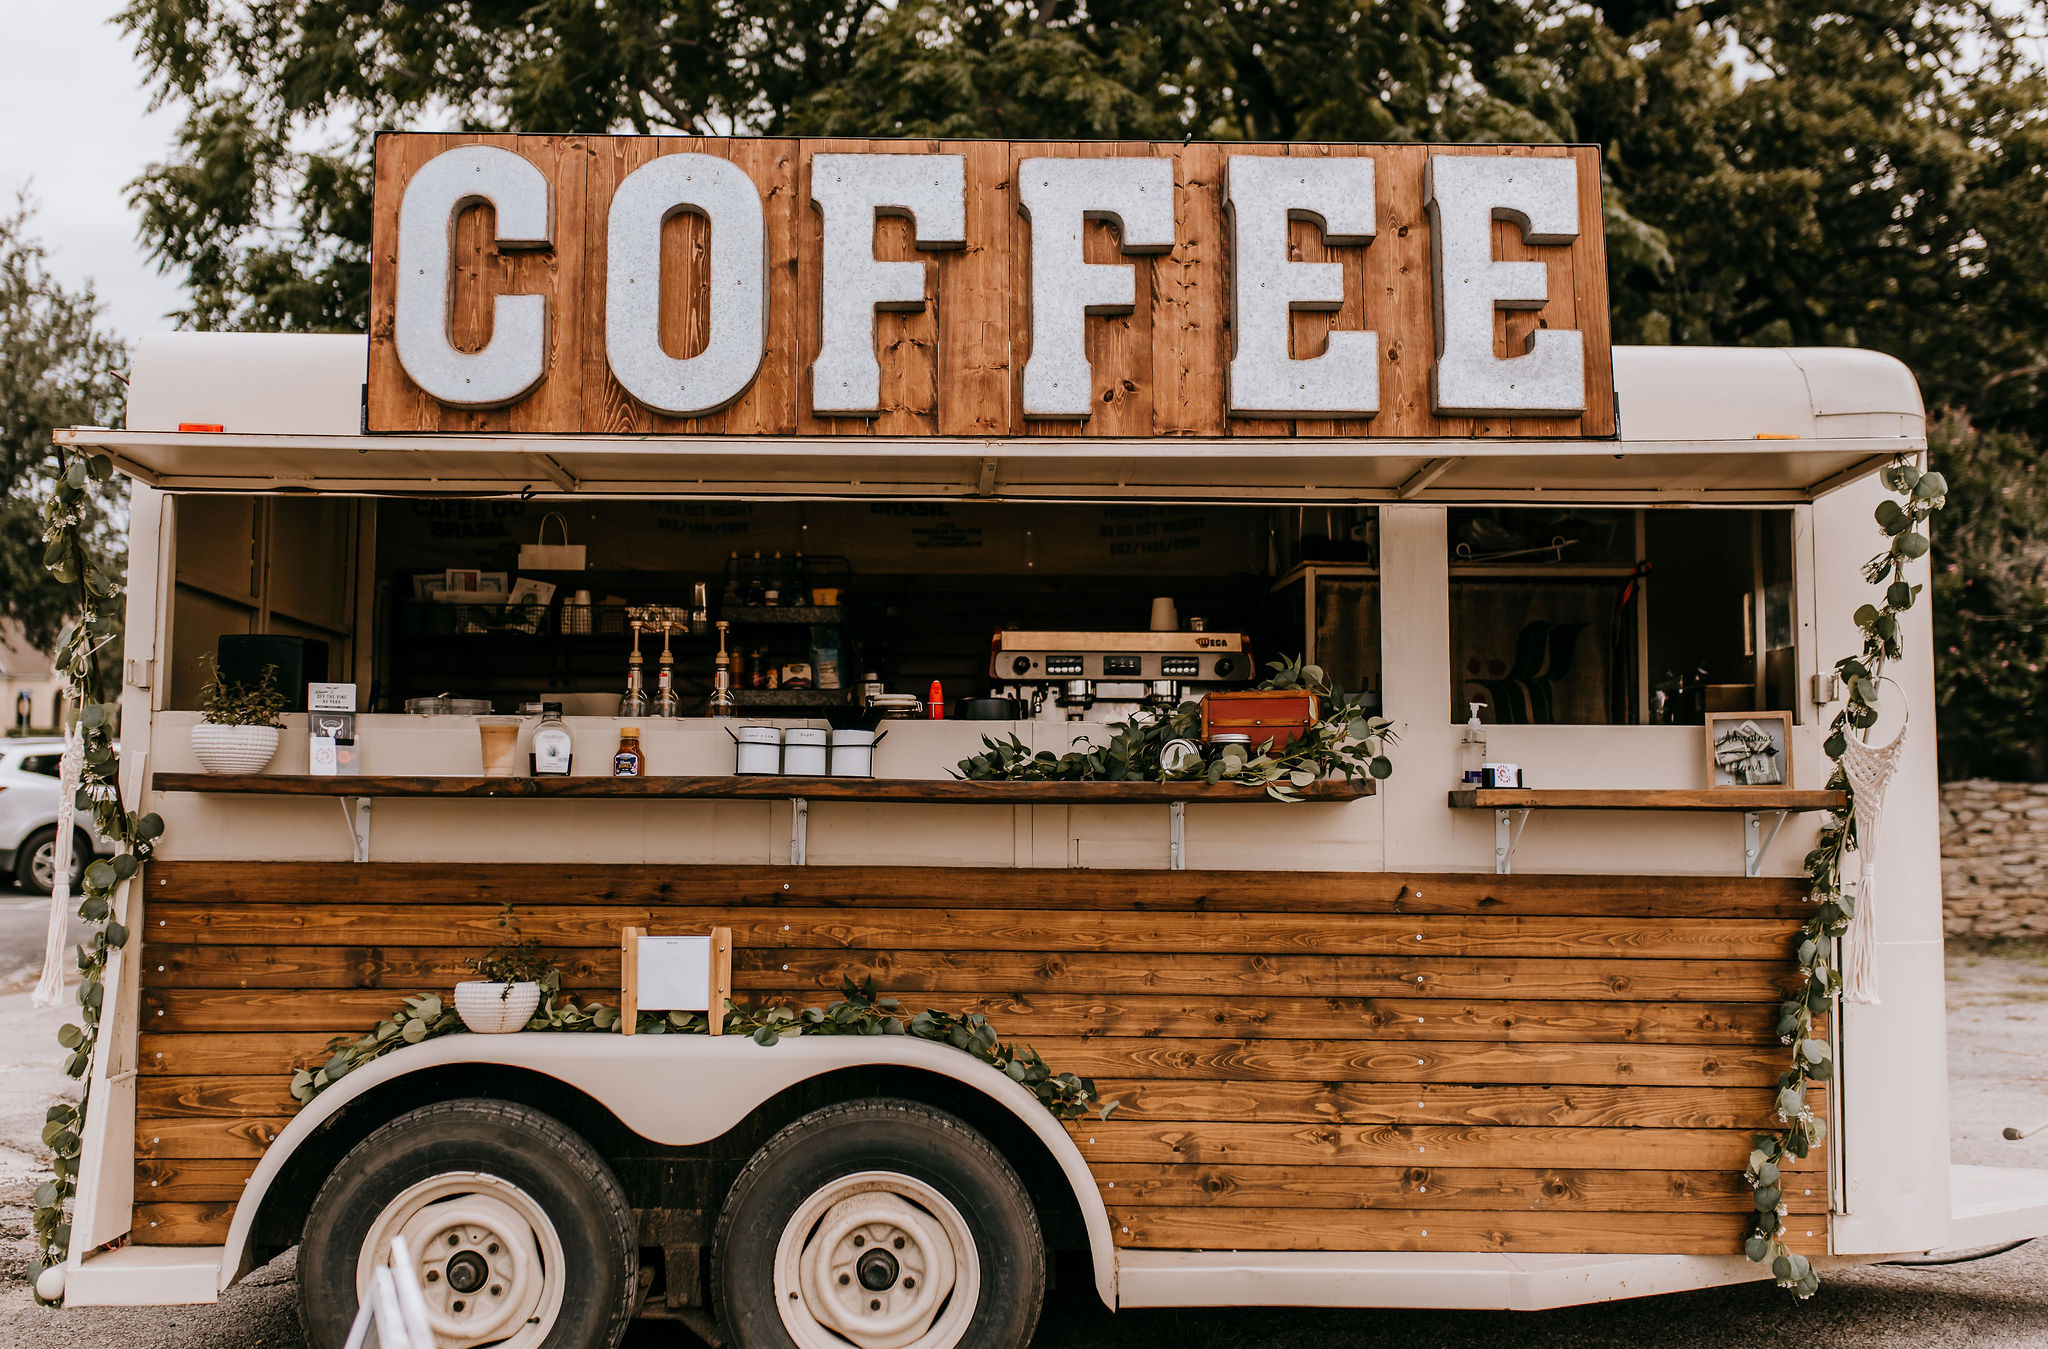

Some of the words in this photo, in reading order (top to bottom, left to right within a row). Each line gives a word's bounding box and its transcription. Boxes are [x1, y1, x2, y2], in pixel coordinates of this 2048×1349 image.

[395, 144, 1587, 418] COFFEE
[430, 520, 512, 538] BRASIL
[1197, 637, 1228, 648] WEGA
